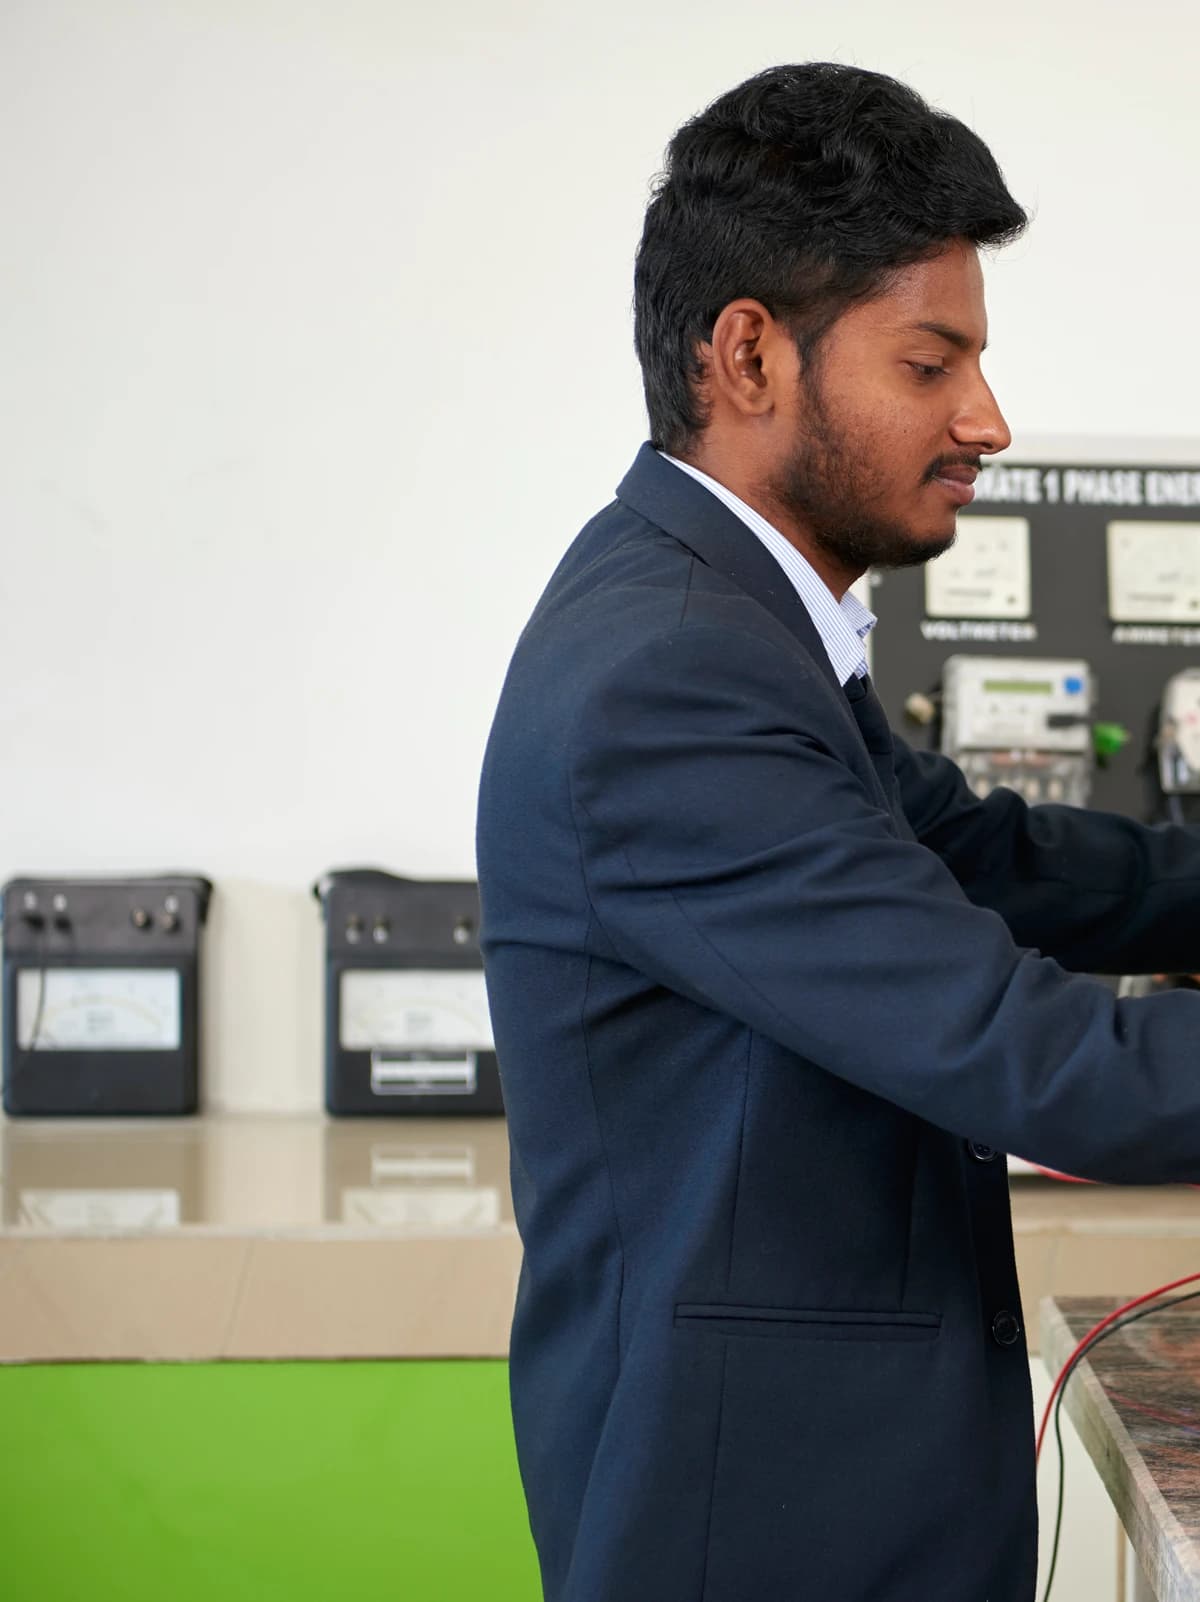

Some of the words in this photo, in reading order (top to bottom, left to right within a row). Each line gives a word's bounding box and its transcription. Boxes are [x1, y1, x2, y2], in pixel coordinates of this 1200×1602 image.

[1044, 470, 1059, 503] 1
[1063, 470, 1143, 504] PHASE
[920, 621, 1038, 641] VOLTMETER
